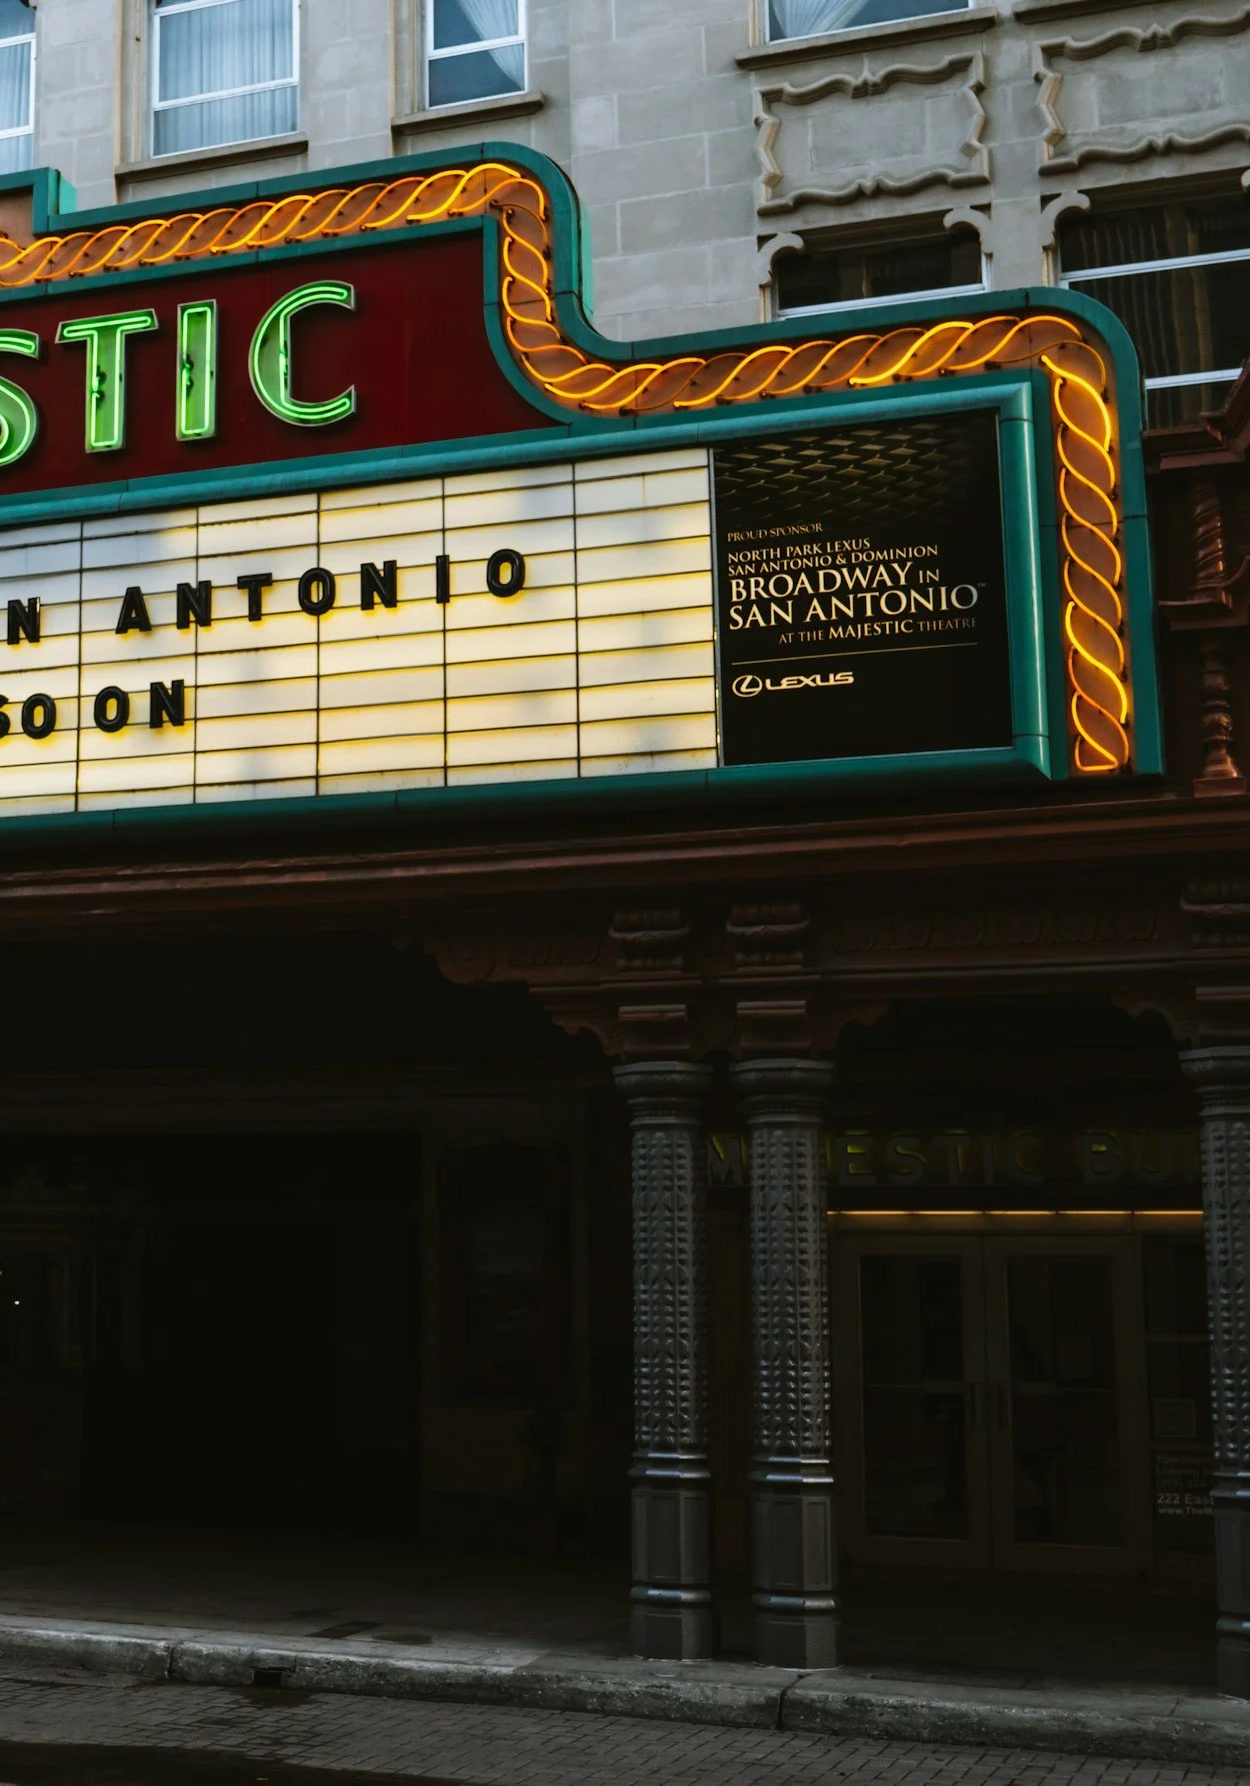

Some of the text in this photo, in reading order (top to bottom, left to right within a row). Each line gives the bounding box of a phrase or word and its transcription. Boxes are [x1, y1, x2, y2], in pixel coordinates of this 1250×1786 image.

[727, 523, 823, 542] PROUD SPONSOR
[728, 537, 871, 564] NORTH PARK LEXUS
[728, 544, 938, 577] SAN ANTONIO & DOMINION
[115, 548, 526, 634] ANTONIO
[730, 561, 940, 602] BROADWAY IN
[729, 600, 794, 631] SAN
[778, 617, 978, 645] AT THE MAJESTIC THEATRE
[765, 671, 855, 691] LEXUS
